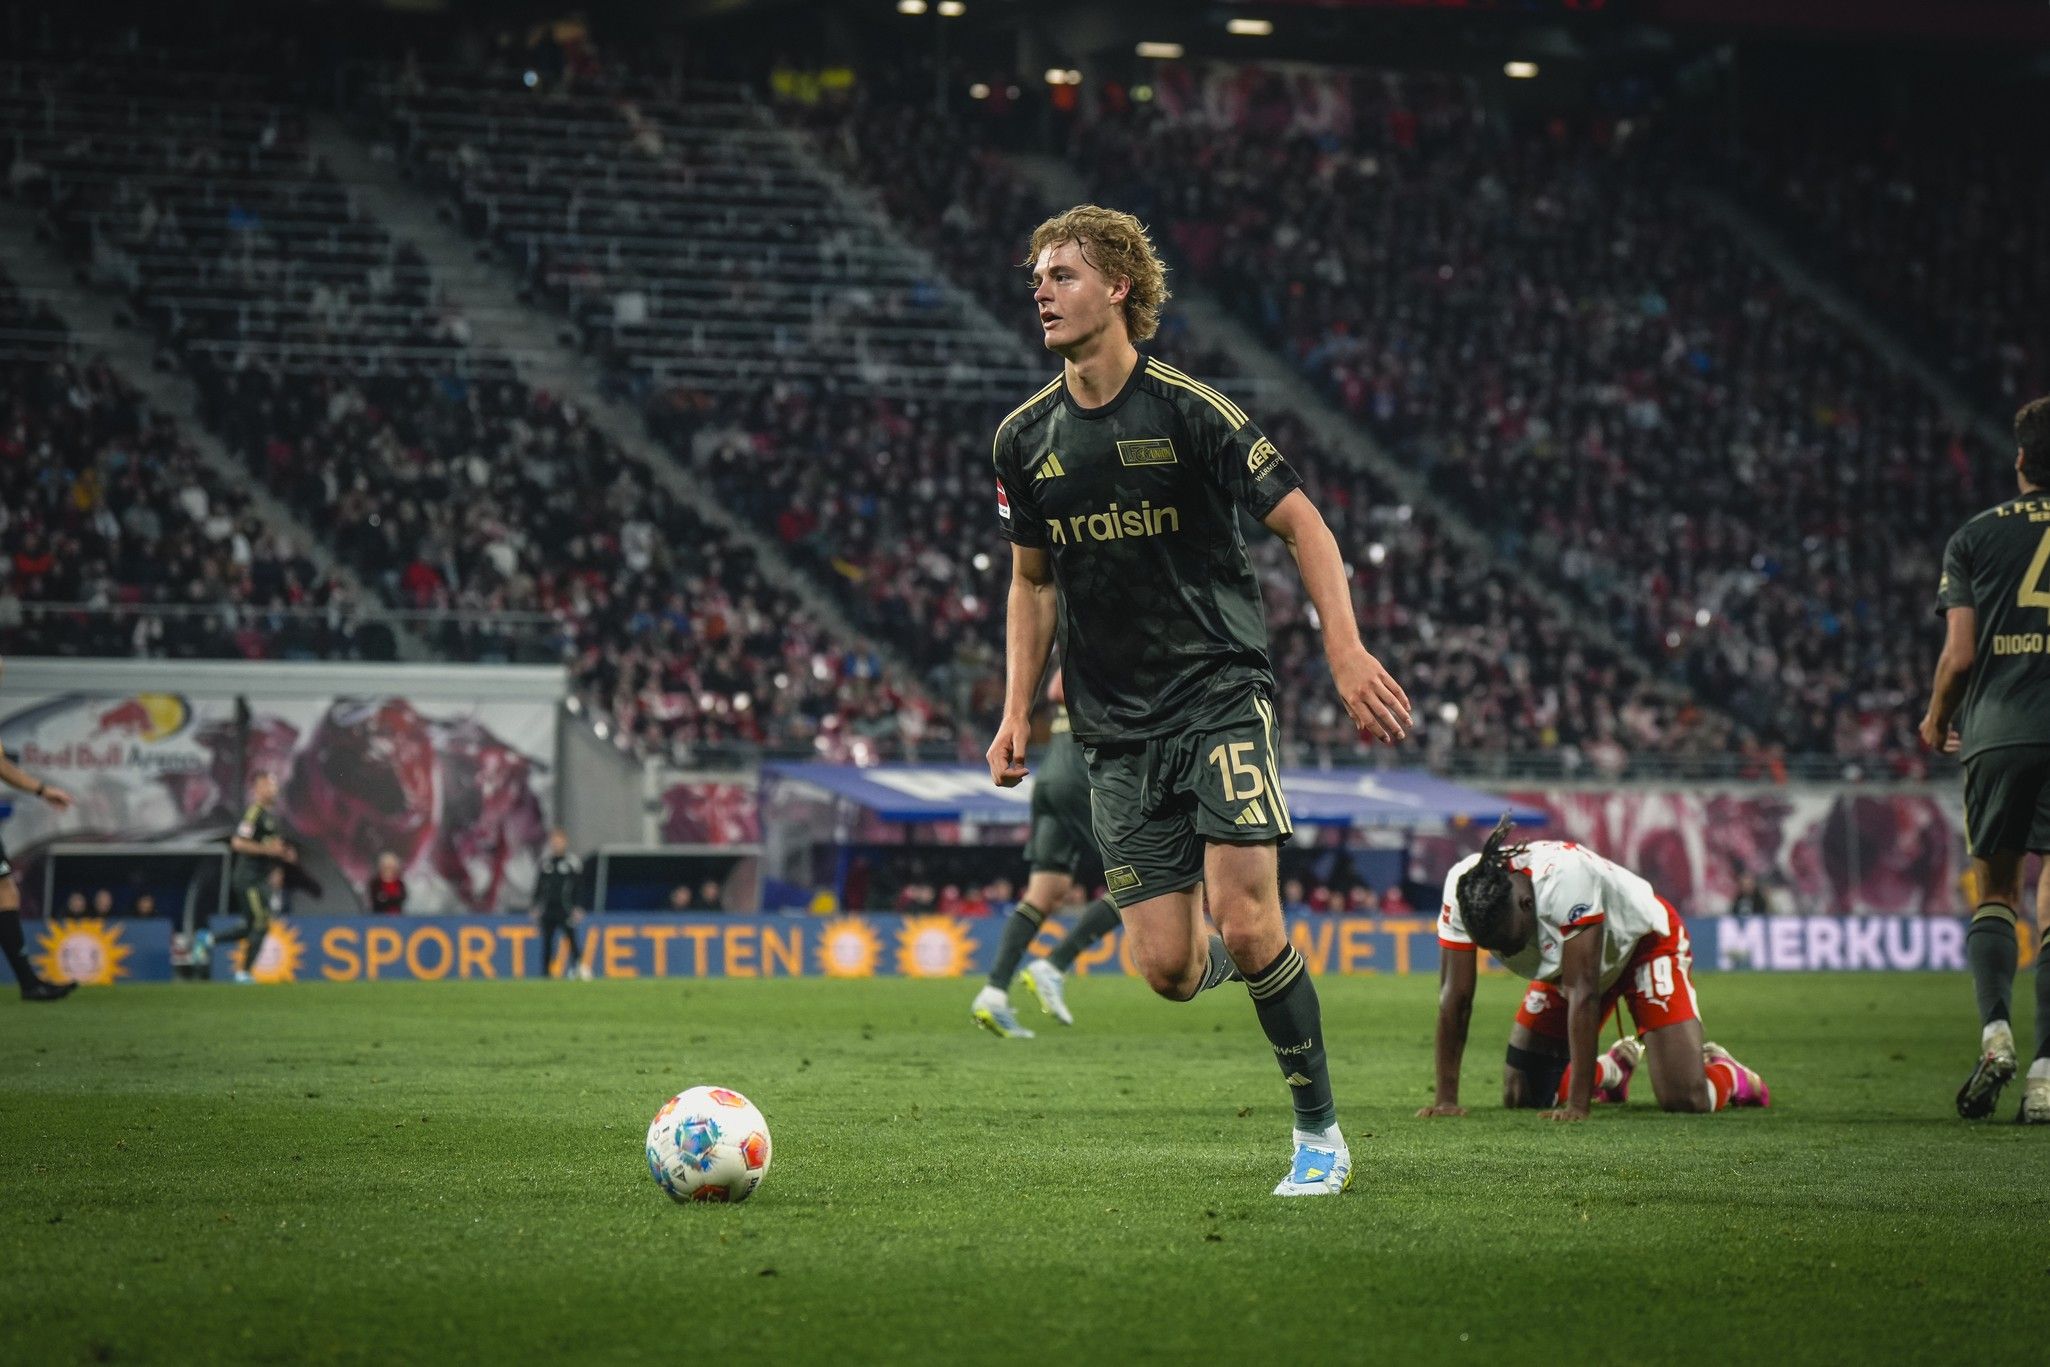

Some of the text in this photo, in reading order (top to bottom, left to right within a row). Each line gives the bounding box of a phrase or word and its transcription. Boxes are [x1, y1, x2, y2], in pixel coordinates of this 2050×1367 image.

[1069, 501, 1179, 542] raisin
[2014, 502, 2036, 513] FC
[1993, 633, 2043, 655] DIOGO
[1209, 742, 1264, 801] 15
[1717, 915, 1966, 970] MERKUR
